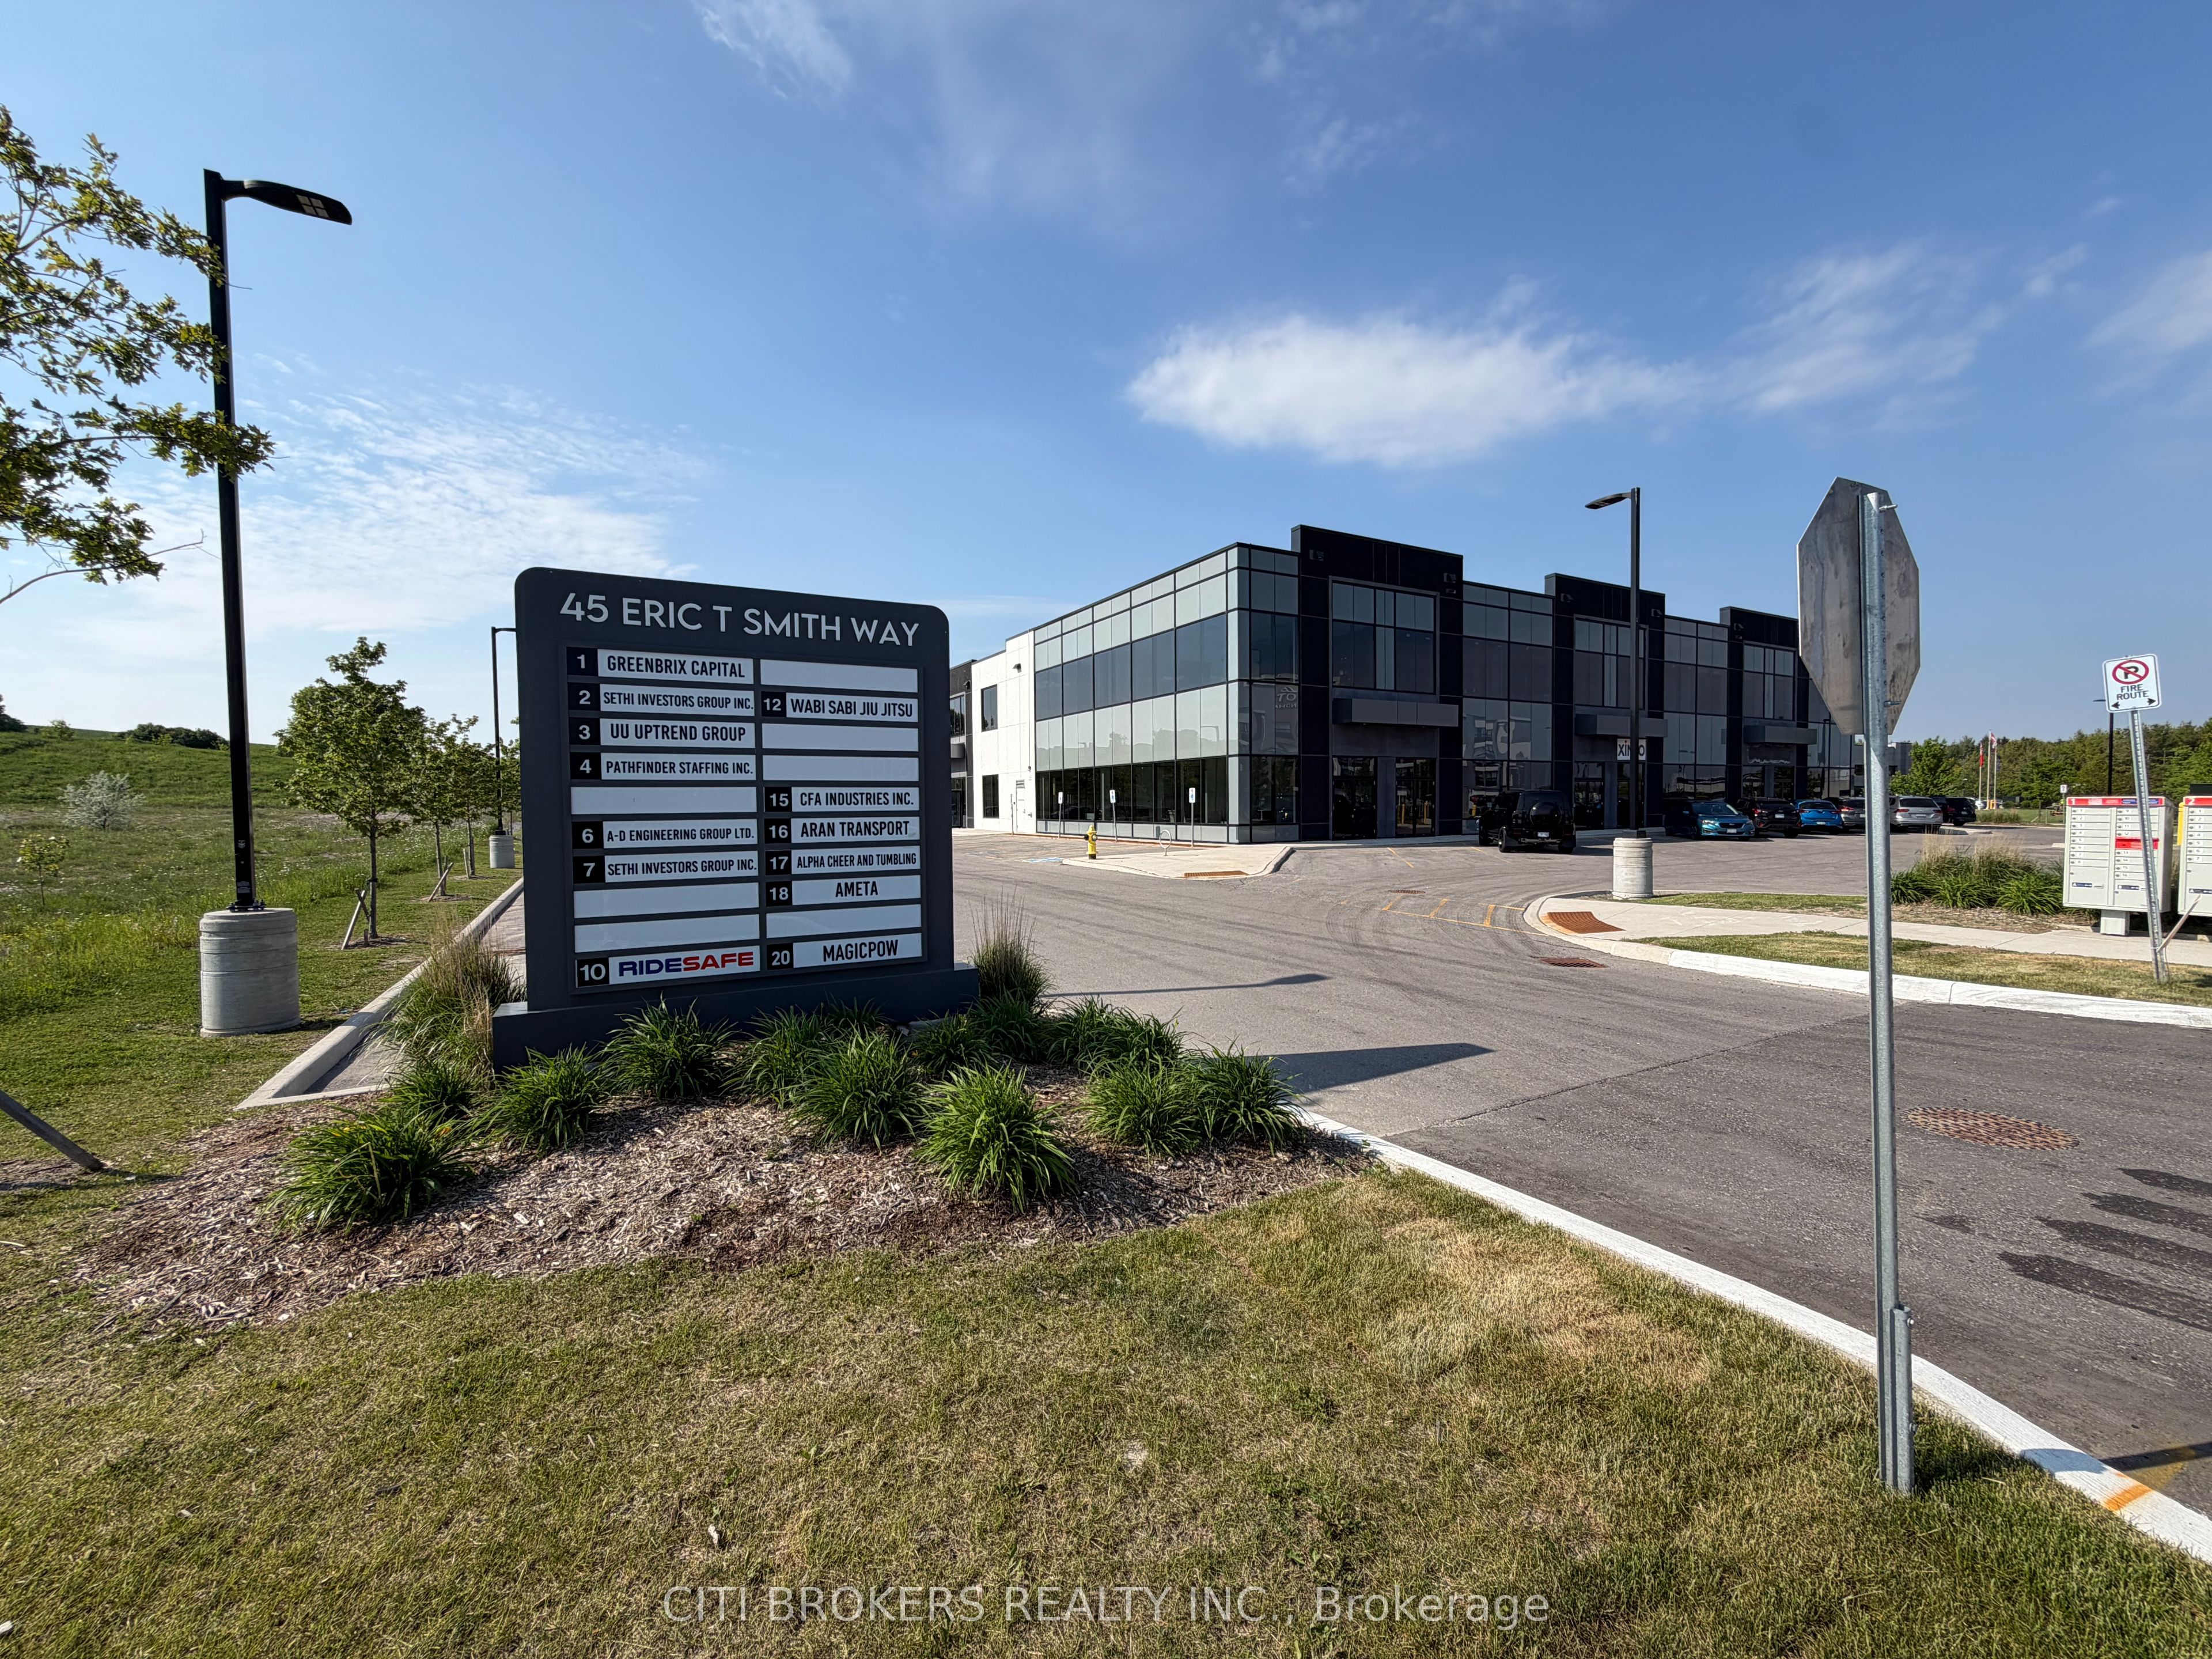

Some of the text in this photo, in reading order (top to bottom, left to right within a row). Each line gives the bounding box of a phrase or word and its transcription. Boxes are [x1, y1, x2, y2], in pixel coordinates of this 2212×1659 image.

[559, 592, 919, 646] 45 ERIC T SMITH WAY
[577, 654, 585, 669] 1
[607, 655, 745, 677] GREENBRIX CAPITAL
[2116, 691, 2149, 700] ROUTE
[2120, 684, 2144, 693] FIRE
[579, 690, 590, 704] 2
[603, 692, 754, 710] SETHI INVESTORS GROUP INC.
[763, 698, 782, 711] 12
[790, 699, 912, 717] WABI SABI JIU JITSU
[578, 725, 590, 740] 3
[610, 724, 746, 741] UU UPTREND GROUP
[579, 759, 592, 774] 4
[606, 761, 753, 775] PATHFINDER STAFFING INC.
[770, 793, 789, 807] 15
[800, 792, 914, 806] CFA INDUSTRIES INC.
[582, 828, 594, 843] 6
[607, 828, 755, 842] A-D ENGINEERING GROUP LTD.
[769, 825, 788, 839] 16
[801, 821, 910, 838] ARAN TRANSPORT
[608, 859, 757, 876] SETHI INVESTORS GROUP INC.
[770, 856, 789, 870] 17
[797, 853, 916, 869] ALPHA CHEER AND TUMBLING
[582, 862, 596, 877] 7
[769, 887, 789, 901] 18
[835, 881, 878, 897] AMETA
[771, 950, 790, 965] 20
[823, 940, 899, 962] MAGICPOW
[579, 963, 605, 980] 10
[619, 952, 753, 977] RIDESAFE
